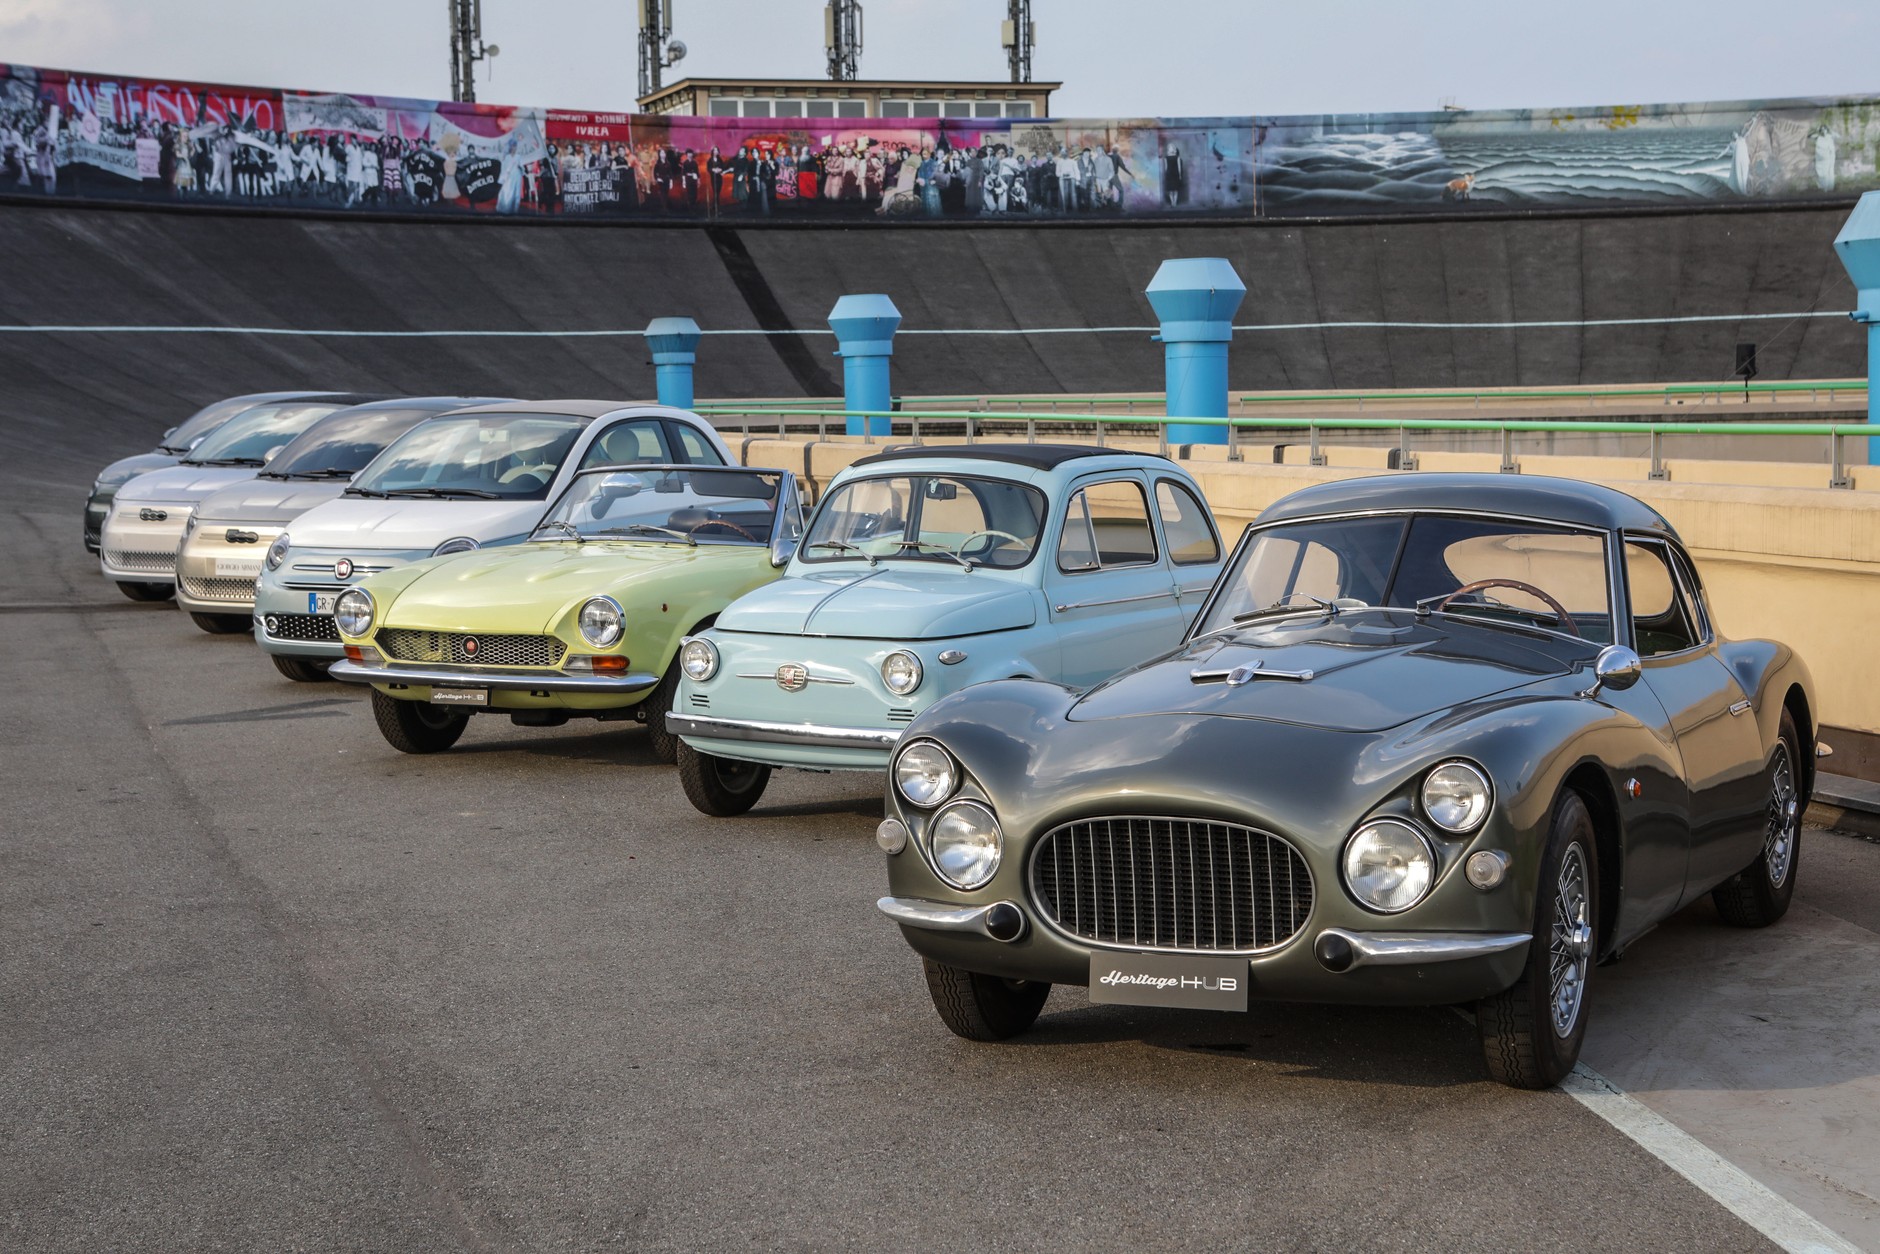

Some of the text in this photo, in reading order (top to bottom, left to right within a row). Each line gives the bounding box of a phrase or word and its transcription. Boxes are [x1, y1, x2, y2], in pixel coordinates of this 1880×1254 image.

[595, 114, 627, 124] DONNE
[576, 126, 609, 136] IVREA
[588, 180, 612, 192] LIBERO
[433, 692, 462, 701] Heritage
[1099, 970, 1238, 992] Heritage HUB
